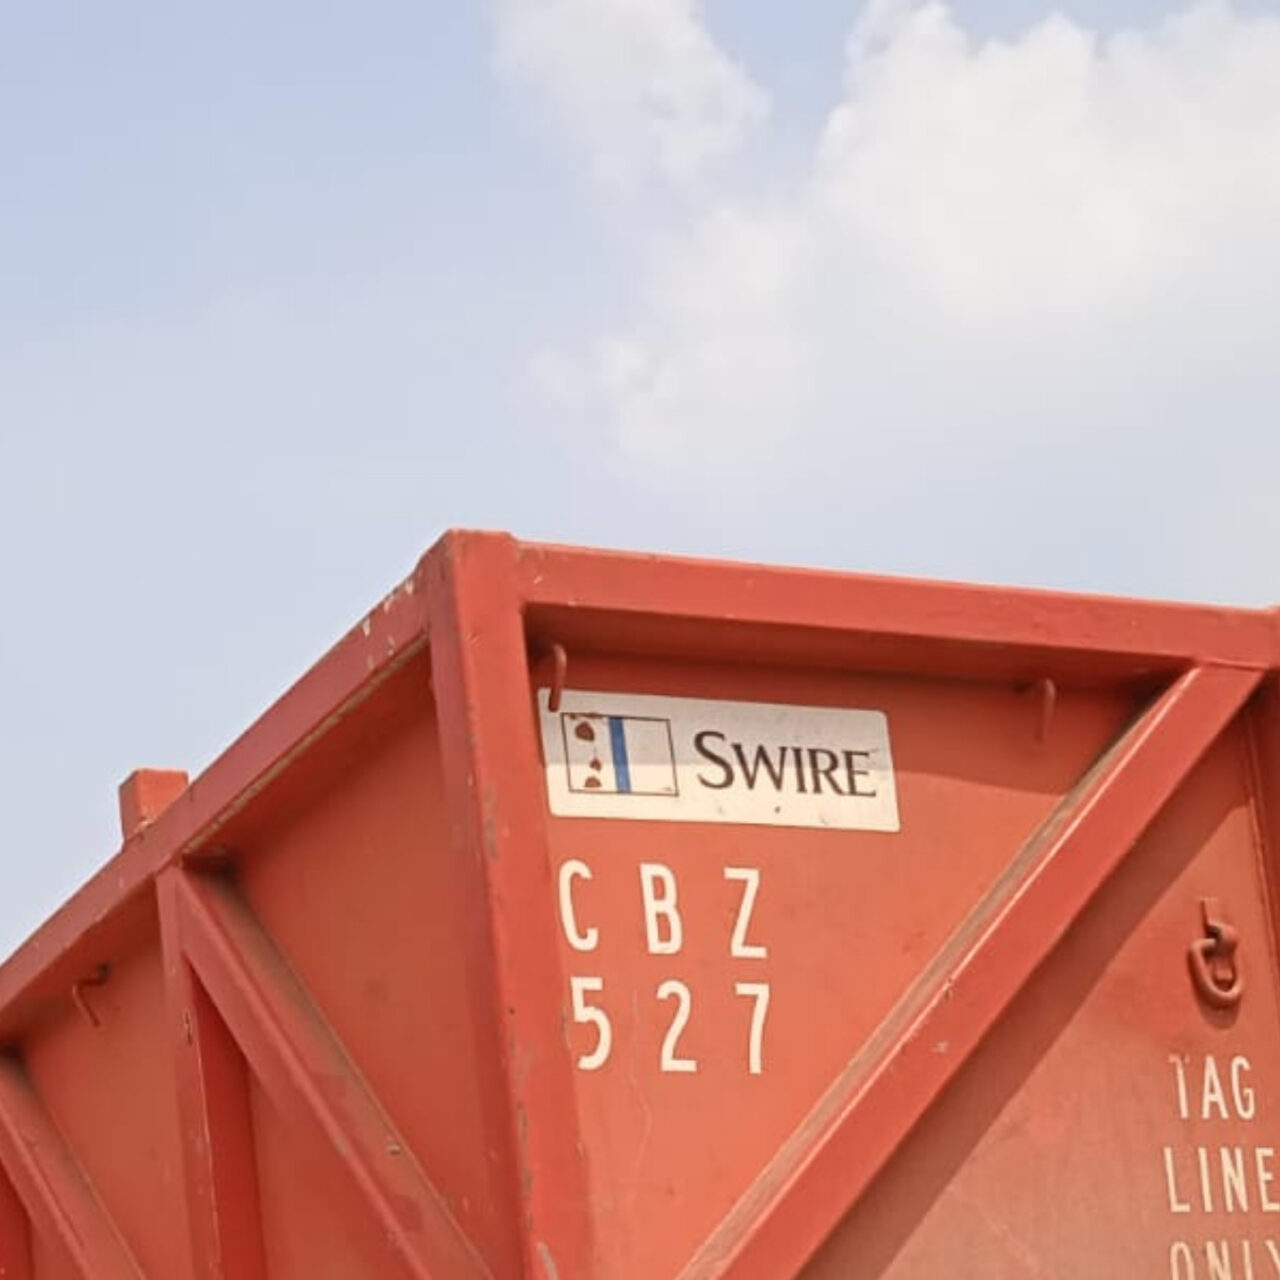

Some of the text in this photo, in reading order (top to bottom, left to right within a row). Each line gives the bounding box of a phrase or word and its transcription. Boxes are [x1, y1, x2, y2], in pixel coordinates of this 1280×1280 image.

[693, 731, 878, 798] SWIRE
[1168, 1054, 1256, 1120] TAG
[1163, 1147, 1280, 1213] LINE
